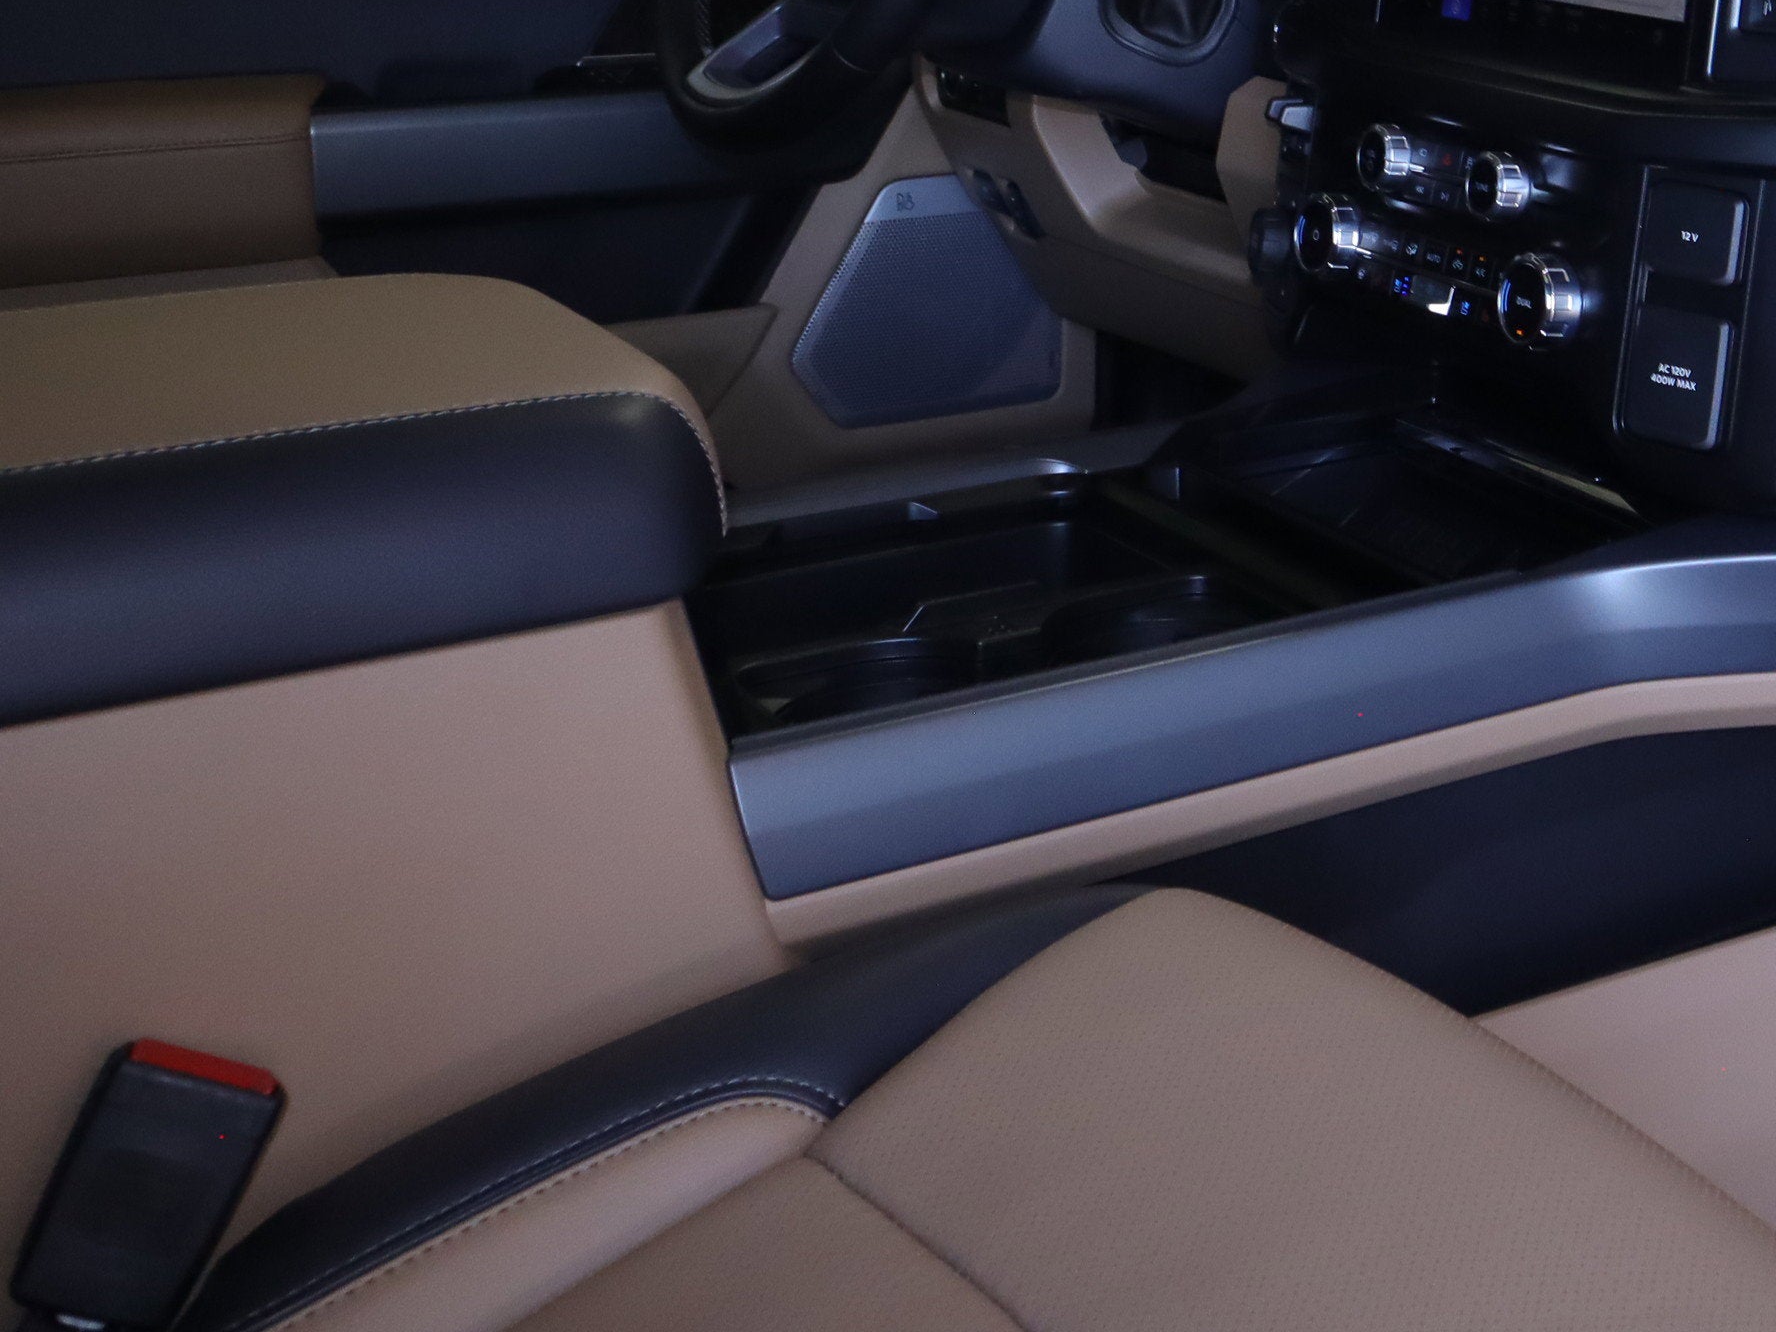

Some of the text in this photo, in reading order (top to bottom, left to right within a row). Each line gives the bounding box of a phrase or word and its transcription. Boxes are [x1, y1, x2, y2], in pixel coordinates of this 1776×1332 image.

[1658, 362, 1692, 379] AC 120V
[1650, 373, 1697, 391] 400W MAX
